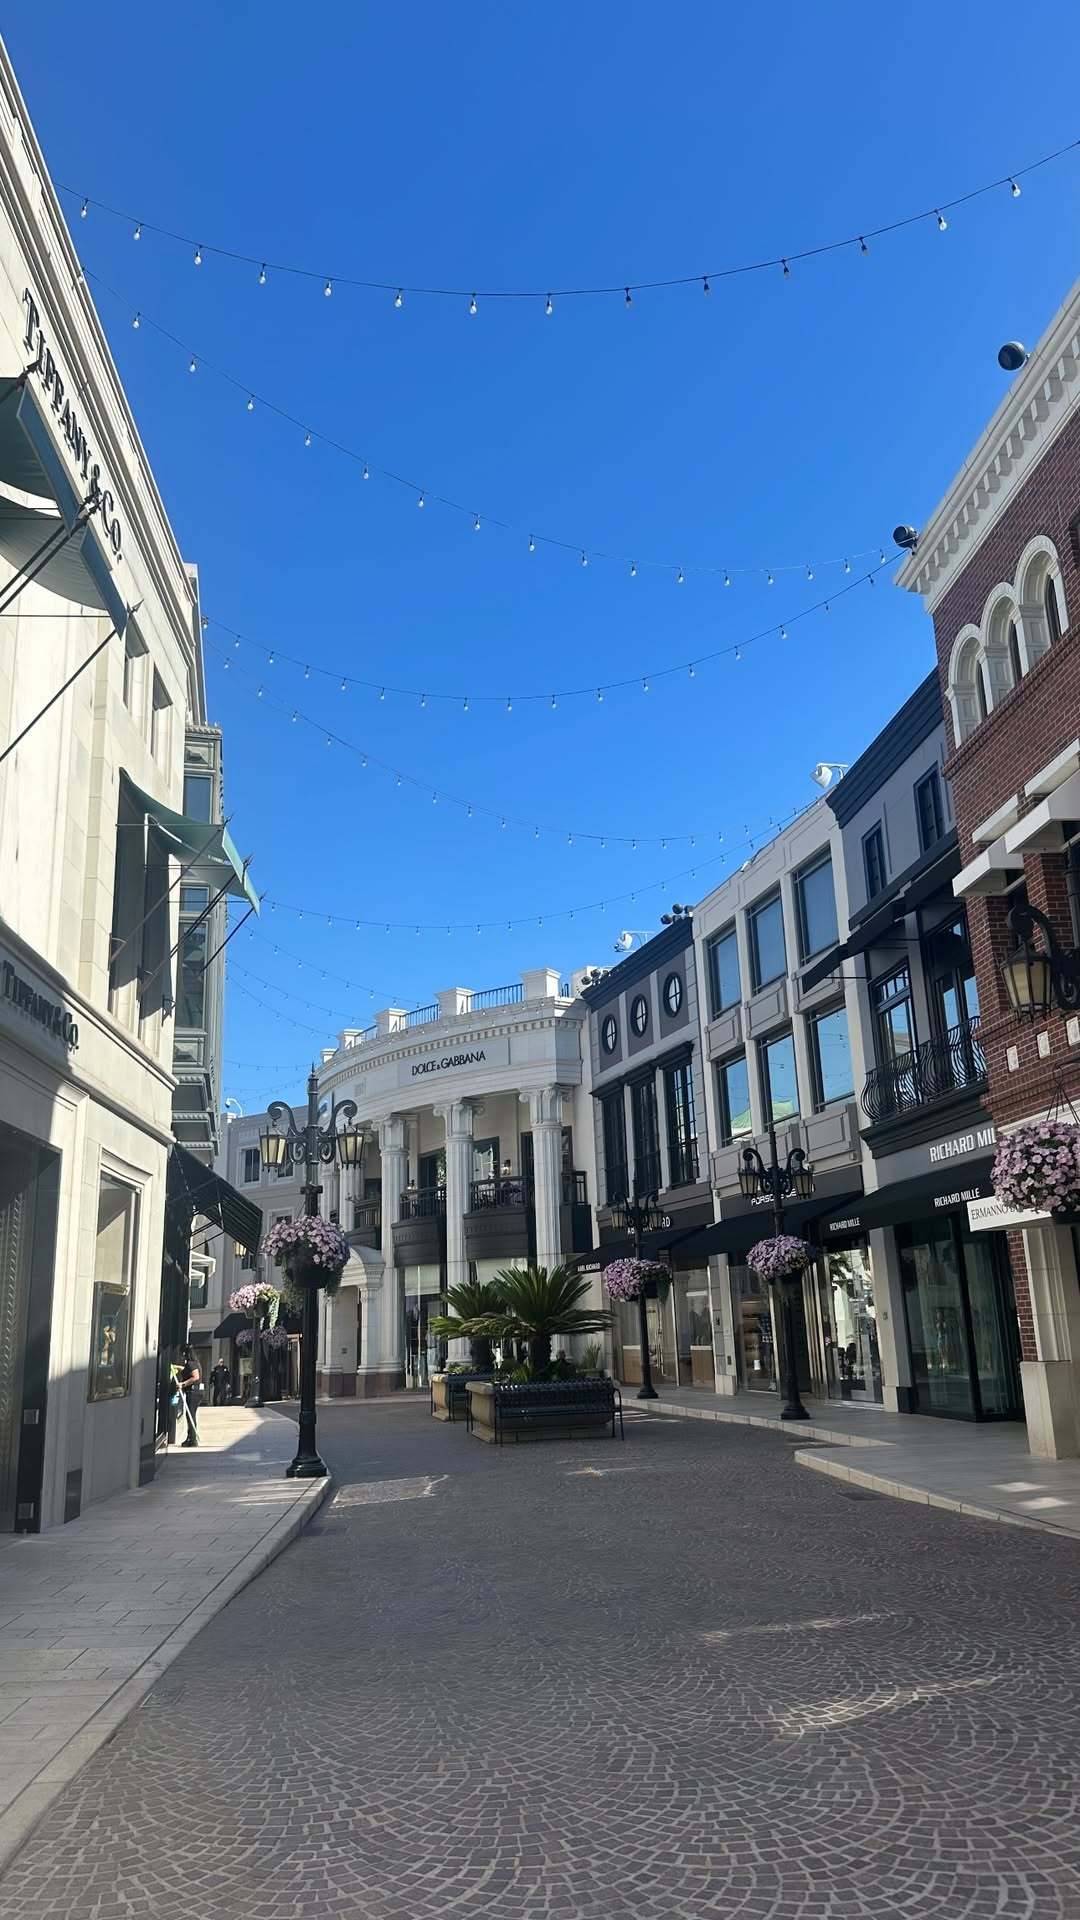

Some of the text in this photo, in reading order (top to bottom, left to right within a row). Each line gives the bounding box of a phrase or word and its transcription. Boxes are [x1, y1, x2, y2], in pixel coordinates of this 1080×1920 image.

[929, 1127, 996, 1162] RICHARD MIL
[934, 1188, 980, 1208] RICHARD MILLE
